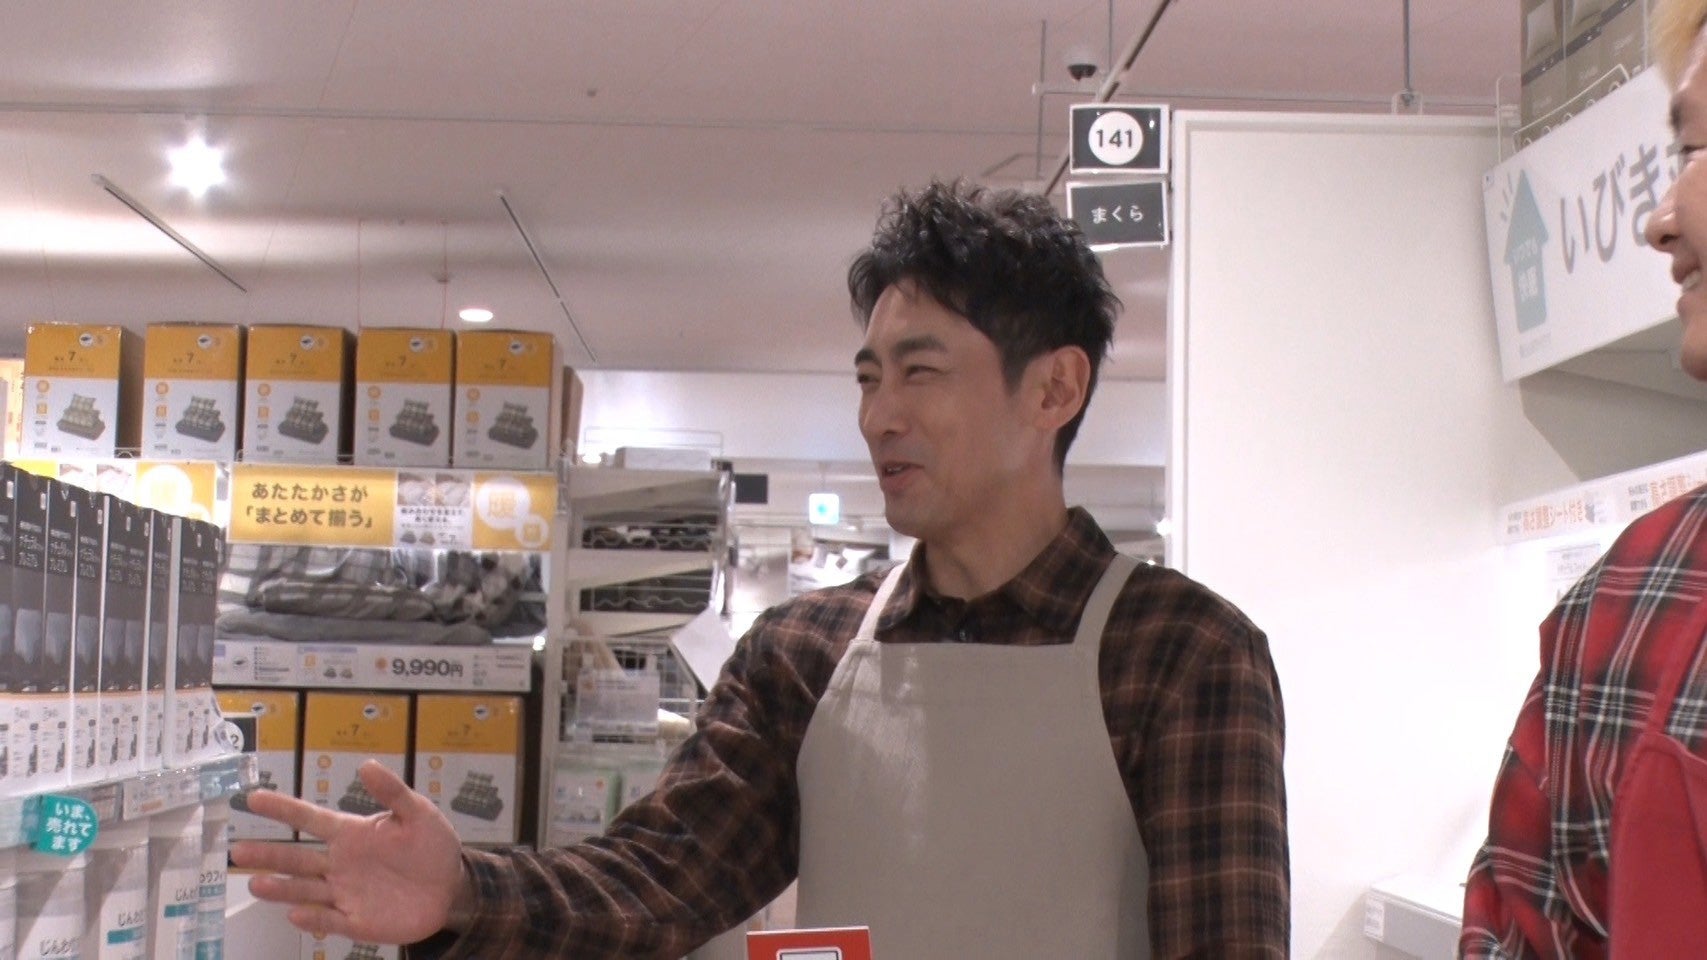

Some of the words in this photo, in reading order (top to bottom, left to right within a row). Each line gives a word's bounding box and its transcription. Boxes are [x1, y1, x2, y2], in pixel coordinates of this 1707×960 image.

[1096, 129, 1132, 148] 141
[1091, 205, 1144, 224] まくら
[252, 482, 369, 502] あたたかさが
[245, 505, 373, 528] 「まとめて揃う」
[392, 658, 464, 677] 9,990円
[56, 802, 90, 820] いま、
[46, 817, 93, 837] 売れて
[51, 836, 82, 852] ます
